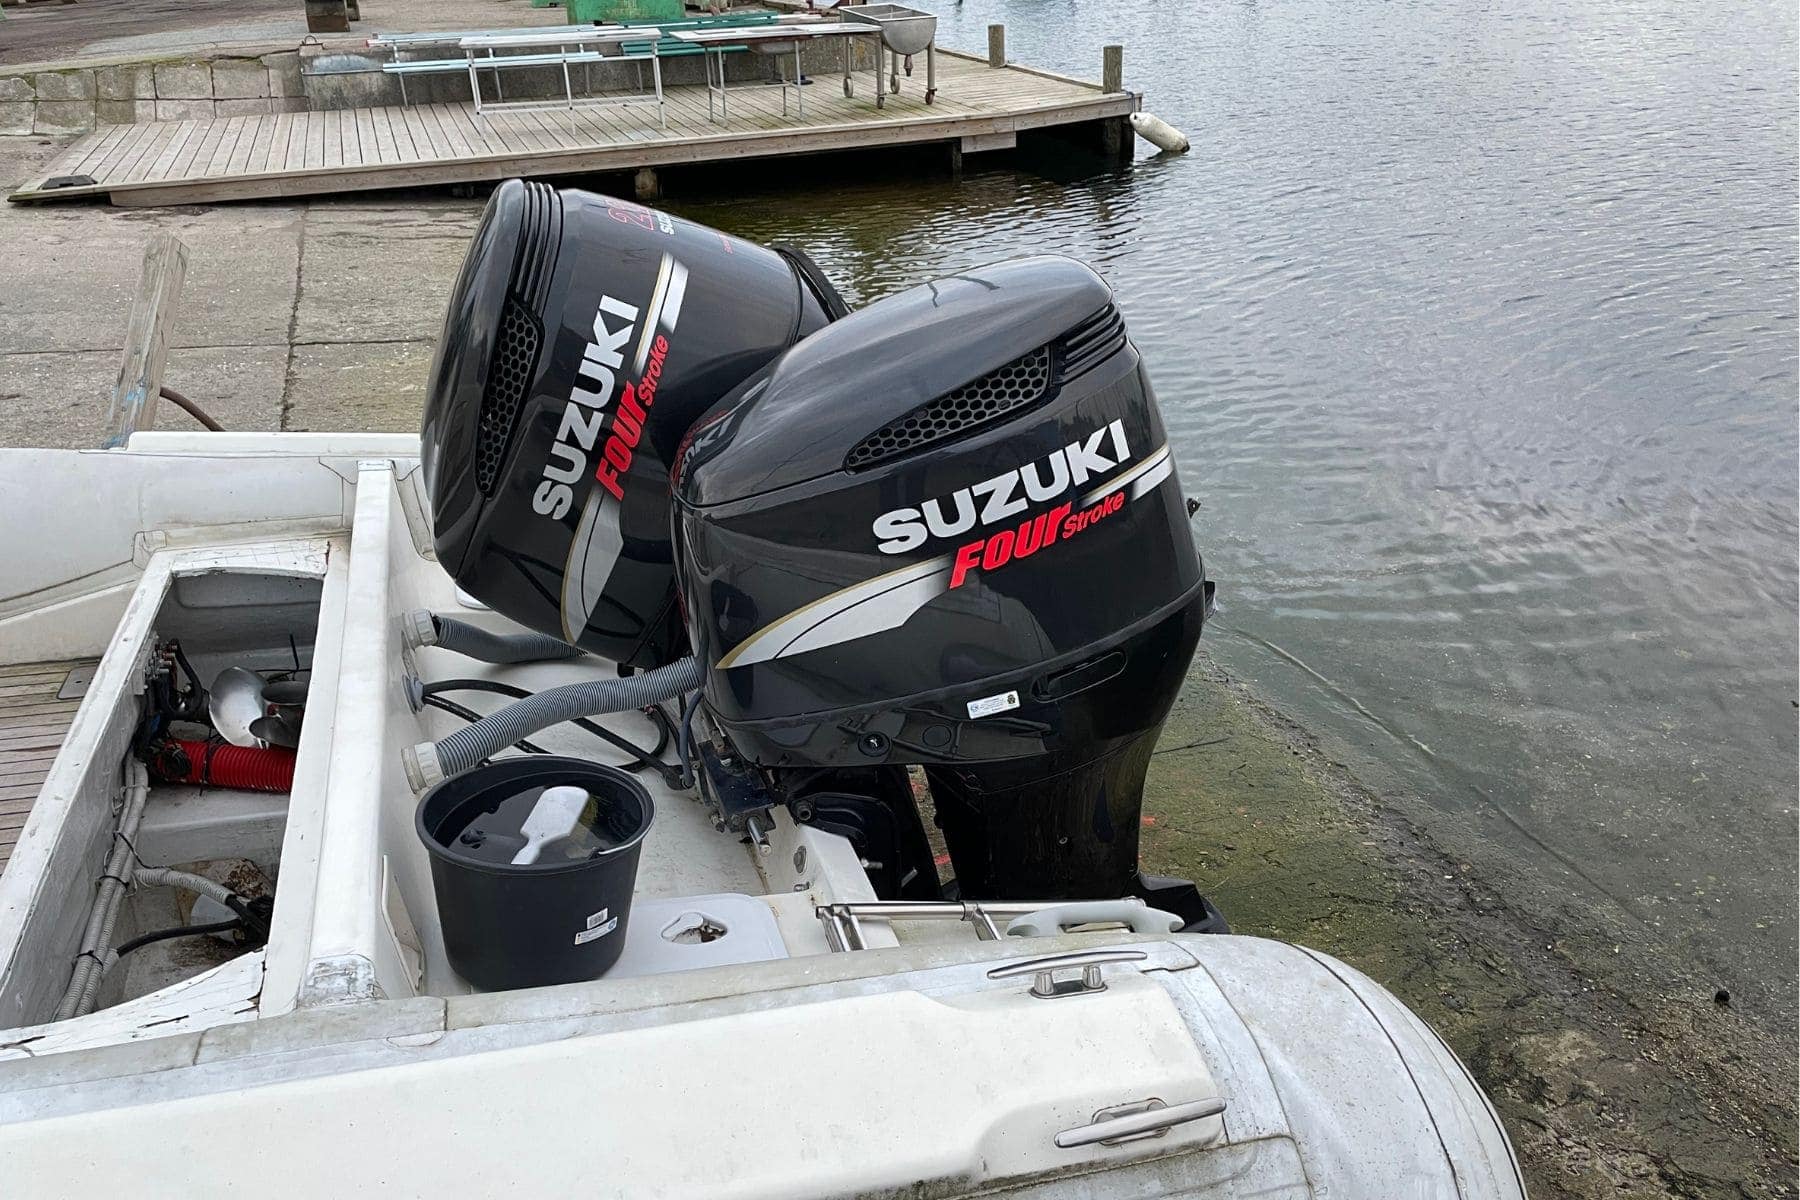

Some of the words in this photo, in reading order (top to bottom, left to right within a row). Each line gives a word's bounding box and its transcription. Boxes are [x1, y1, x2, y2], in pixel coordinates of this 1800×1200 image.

[532, 294, 640, 520] SUZUKI
[638, 334, 669, 407] Stroke
[872, 418, 1131, 555] SUZUKI
[1062, 491, 1125, 540] Stroke
